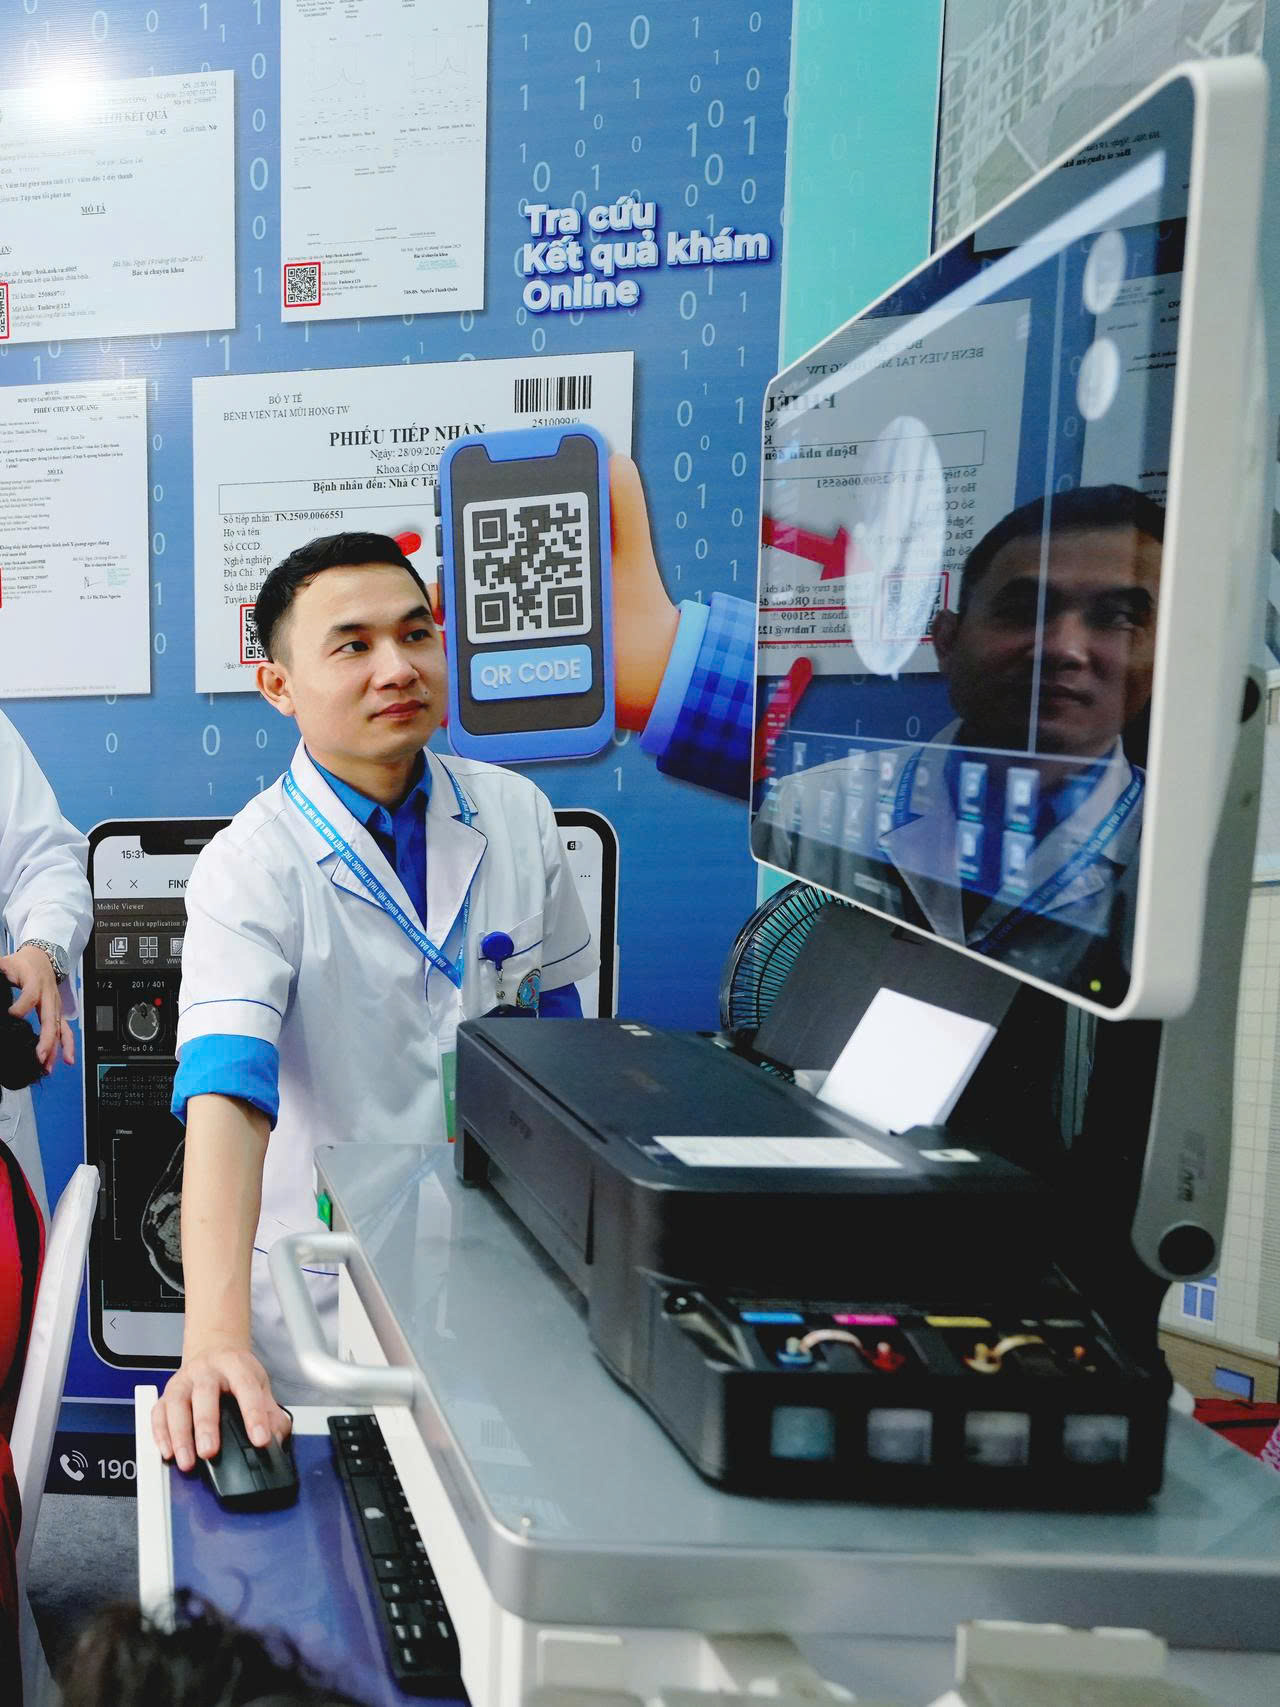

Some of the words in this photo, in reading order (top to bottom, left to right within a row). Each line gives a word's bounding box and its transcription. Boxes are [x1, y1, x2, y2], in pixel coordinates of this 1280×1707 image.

[524, 204, 581, 237] Tra
[588, 196, 656, 232] cứu
[523, 235, 584, 275] Kết
[590, 229, 659, 277] quả
[667, 227, 769, 266] khám
[523, 274, 640, 313] Online
[282, 394, 290, 404] Y
[272, 408, 288, 419] TAI
[332, 405, 351, 416] TW
[328, 425, 384, 448] PHIẾU
[390, 422, 429, 445] TIẾP
[370, 447, 396, 460] Ngày:
[375, 464, 400, 476] Khoa
[313, 481, 337, 493] Bệnh
[339, 480, 363, 491] nhân
[366, 478, 386, 490] đến:
[389, 477, 409, 489] Nhà
[411, 478, 420, 487] C
[223, 514, 234, 524] Số
[234, 513, 250, 525] tiếp
[275, 511, 344, 522] TN.2509.0066551
[223, 528, 235, 538] Họ
[236, 528, 246, 536] và
[247, 527, 260, 536] tên
[223, 541, 234, 552] Số
[235, 541, 261, 551] CCCD
[223, 556, 244, 567] Nghề
[223, 569, 237, 579] Địa
[223, 582, 234, 591] Số
[480, 664, 513, 689] QR
[518, 658, 581, 683] CODE
[121, 850, 145, 859] 15:31
[96, 903, 120, 911] Mobile
[121, 903, 145, 911] Viewer
[146, 920, 181, 928] application
